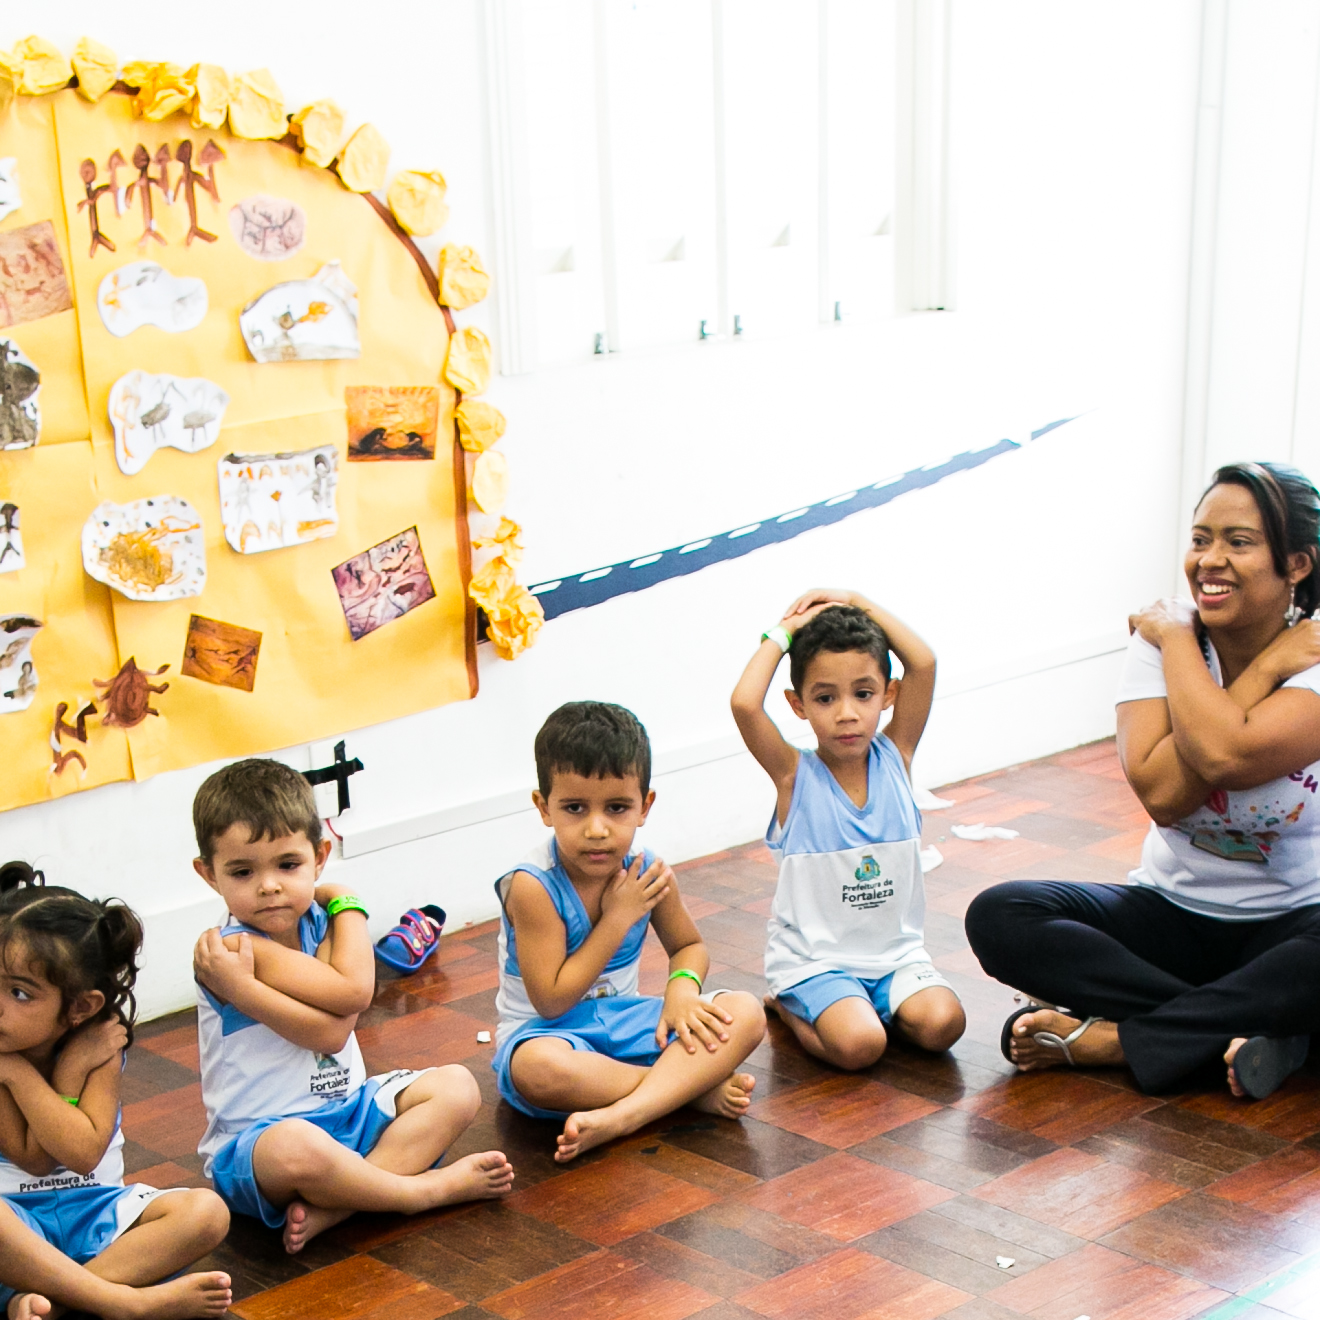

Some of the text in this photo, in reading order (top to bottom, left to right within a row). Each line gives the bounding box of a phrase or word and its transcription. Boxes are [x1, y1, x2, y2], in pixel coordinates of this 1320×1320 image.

[842, 878, 893, 891] Prefeitura de
[842, 889, 894, 903] Fortaleza
[310, 1077, 350, 1092] Fortalez
[20, 1176, 80, 1192] Prefeitura
